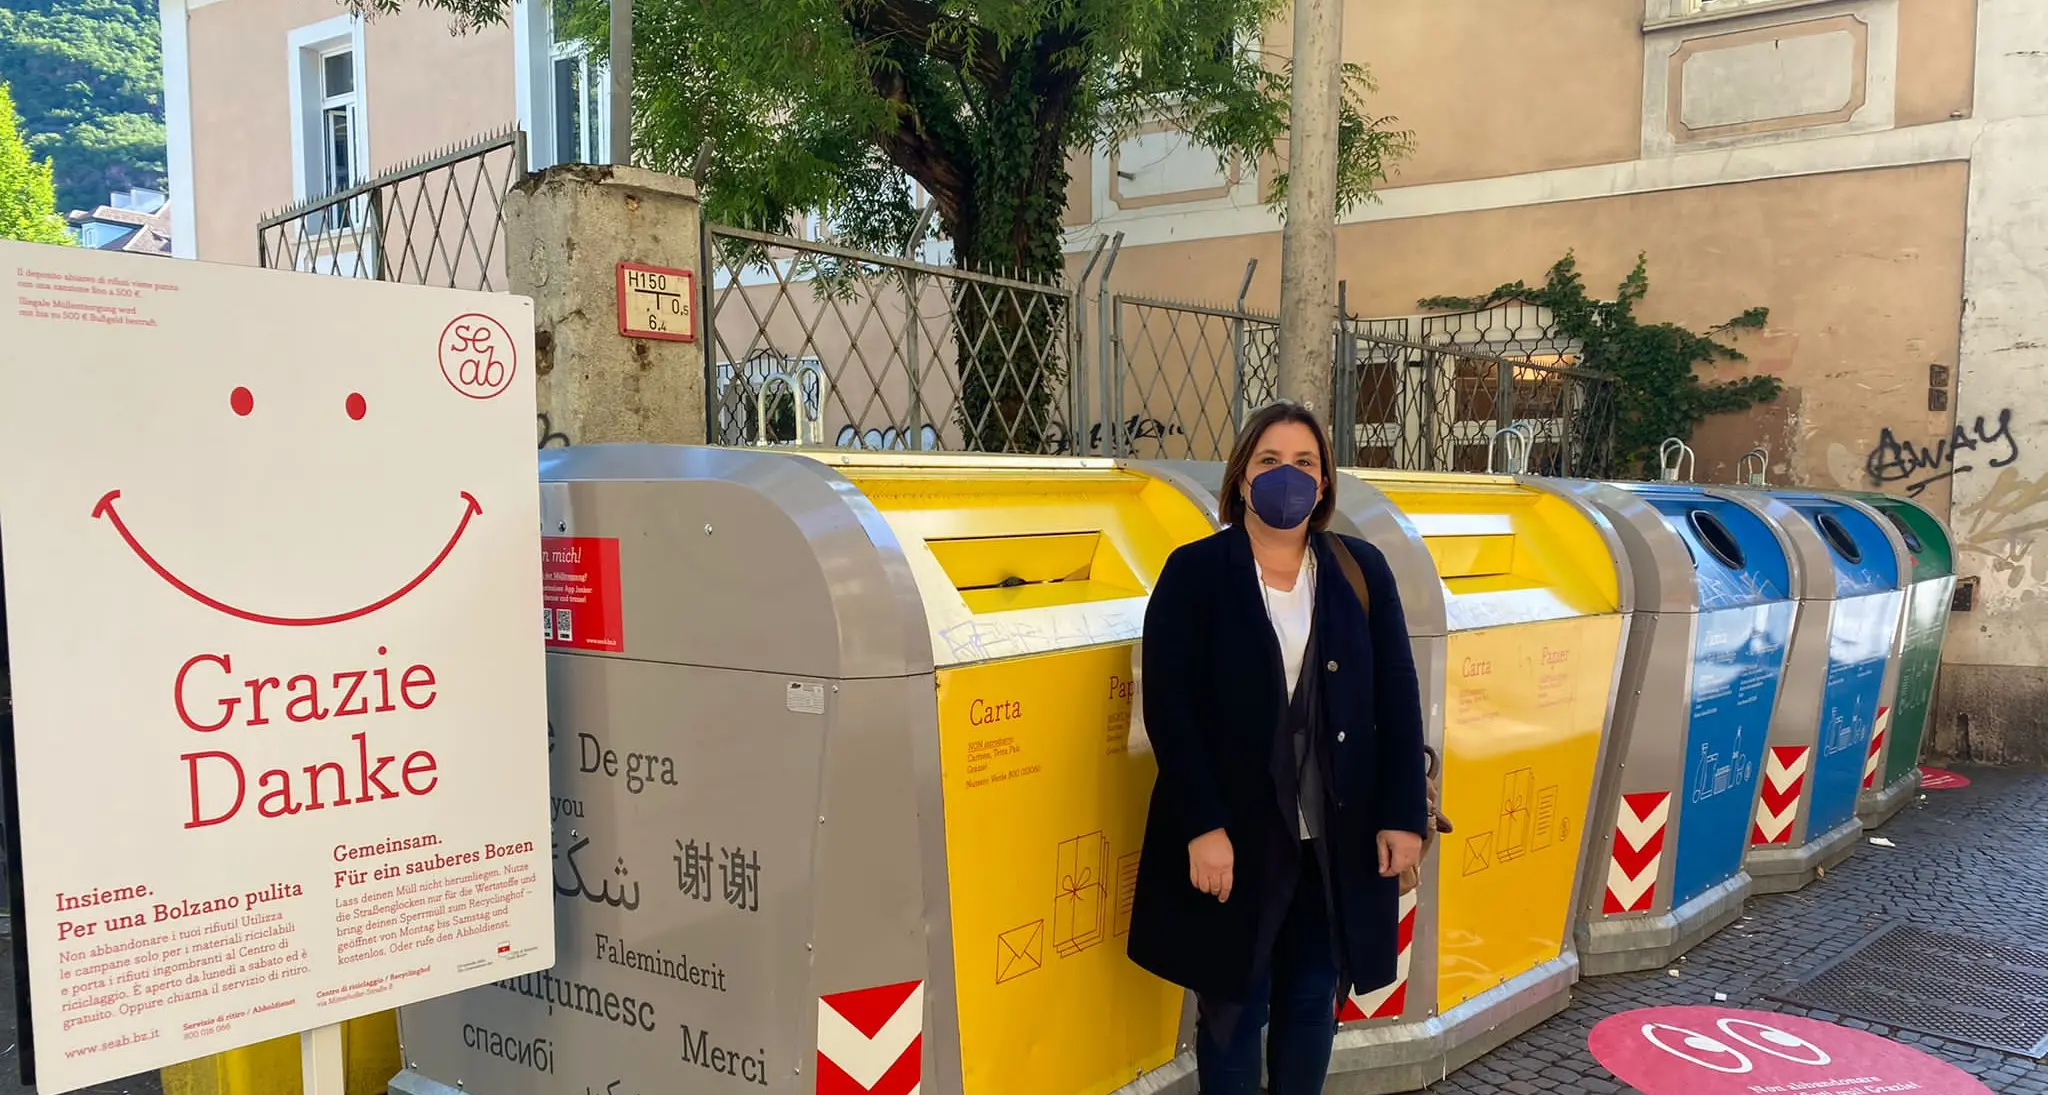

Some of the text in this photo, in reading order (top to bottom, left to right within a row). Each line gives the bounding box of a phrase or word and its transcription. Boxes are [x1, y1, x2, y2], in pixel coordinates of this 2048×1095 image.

[628, 271, 666, 290] H150
[174, 646, 437, 732] Grazie
[1462, 656, 1492, 678] Carta
[969, 698, 1022, 727] Carta
[180, 732, 438, 829] Danke
[551, 798, 585, 821] you
[333, 834, 442, 862] Gemeinsam.
[334, 841, 533, 888] Für ein sauberes Bozen
[56, 884, 154, 912] Insieme.
[336, 863, 528, 908] Lass deinen Müll nicht herumliegen. Nutze
[336, 873, 536, 922] die Straßenglocken nur für die Wertstoffe und
[673, 838, 760, 912] 谢谢
[57, 883, 303, 941] Per una Bolzano pulita
[336, 888, 524, 938] bring deinen Sperrmüll zum Recyclinghof
[337, 905, 508, 953] geöffnet von Montag bis Samstag und
[60, 950, 86, 963] Non
[89, 935, 169, 957] abbandonare
[179, 926, 201, 940] tuoi
[204, 918, 238, 934] rifiuti!
[241, 912, 283, 927] Utilizza
[60, 969, 71, 979] le
[75, 958, 130, 976] campane
[134, 951, 159, 964] solo
[162, 947, 181, 962] per
[192, 932, 242, 952] materiali
[245, 923, 295, 942] riciclabili
[389, 942, 413, 953] Oder
[416, 935, 434, 948] rufe
[436, 931, 453, 942] den
[61, 988, 68, 996] e
[72, 979, 105, 996] porta
[116, 970, 150, 985] rifiuti
[153, 954, 222, 977] ingombranti
[225, 949, 236, 960] al
[239, 943, 276, 958] Centro
[278, 938, 289, 949] di
[62, 990, 129, 1011] riciclaggio.
[145, 978, 182, 996] aperto
[185, 974, 200, 984] da
[202, 965, 236, 981] lunedì
[239, 965, 245, 973] a
[248, 955, 284, 971] sabato
[286, 951, 298, 963] ed
[301, 948, 308, 959] è
[595, 933, 727, 993] Faleminderit
[119, 998, 164, 1016] Oppure
[167, 987, 208, 1005] chiama
[211, 983, 219, 994] il
[222, 974, 266, 992] servizio
[268, 970, 279, 981] di
[281, 965, 311, 979] ritiro.
[64, 1029, 160, 1059] www.seab.bz.it
[463, 1022, 554, 1075] спасибі
[680, 1023, 768, 1086] Merci
[1788, 1075, 1882, 1091] abbandonare
